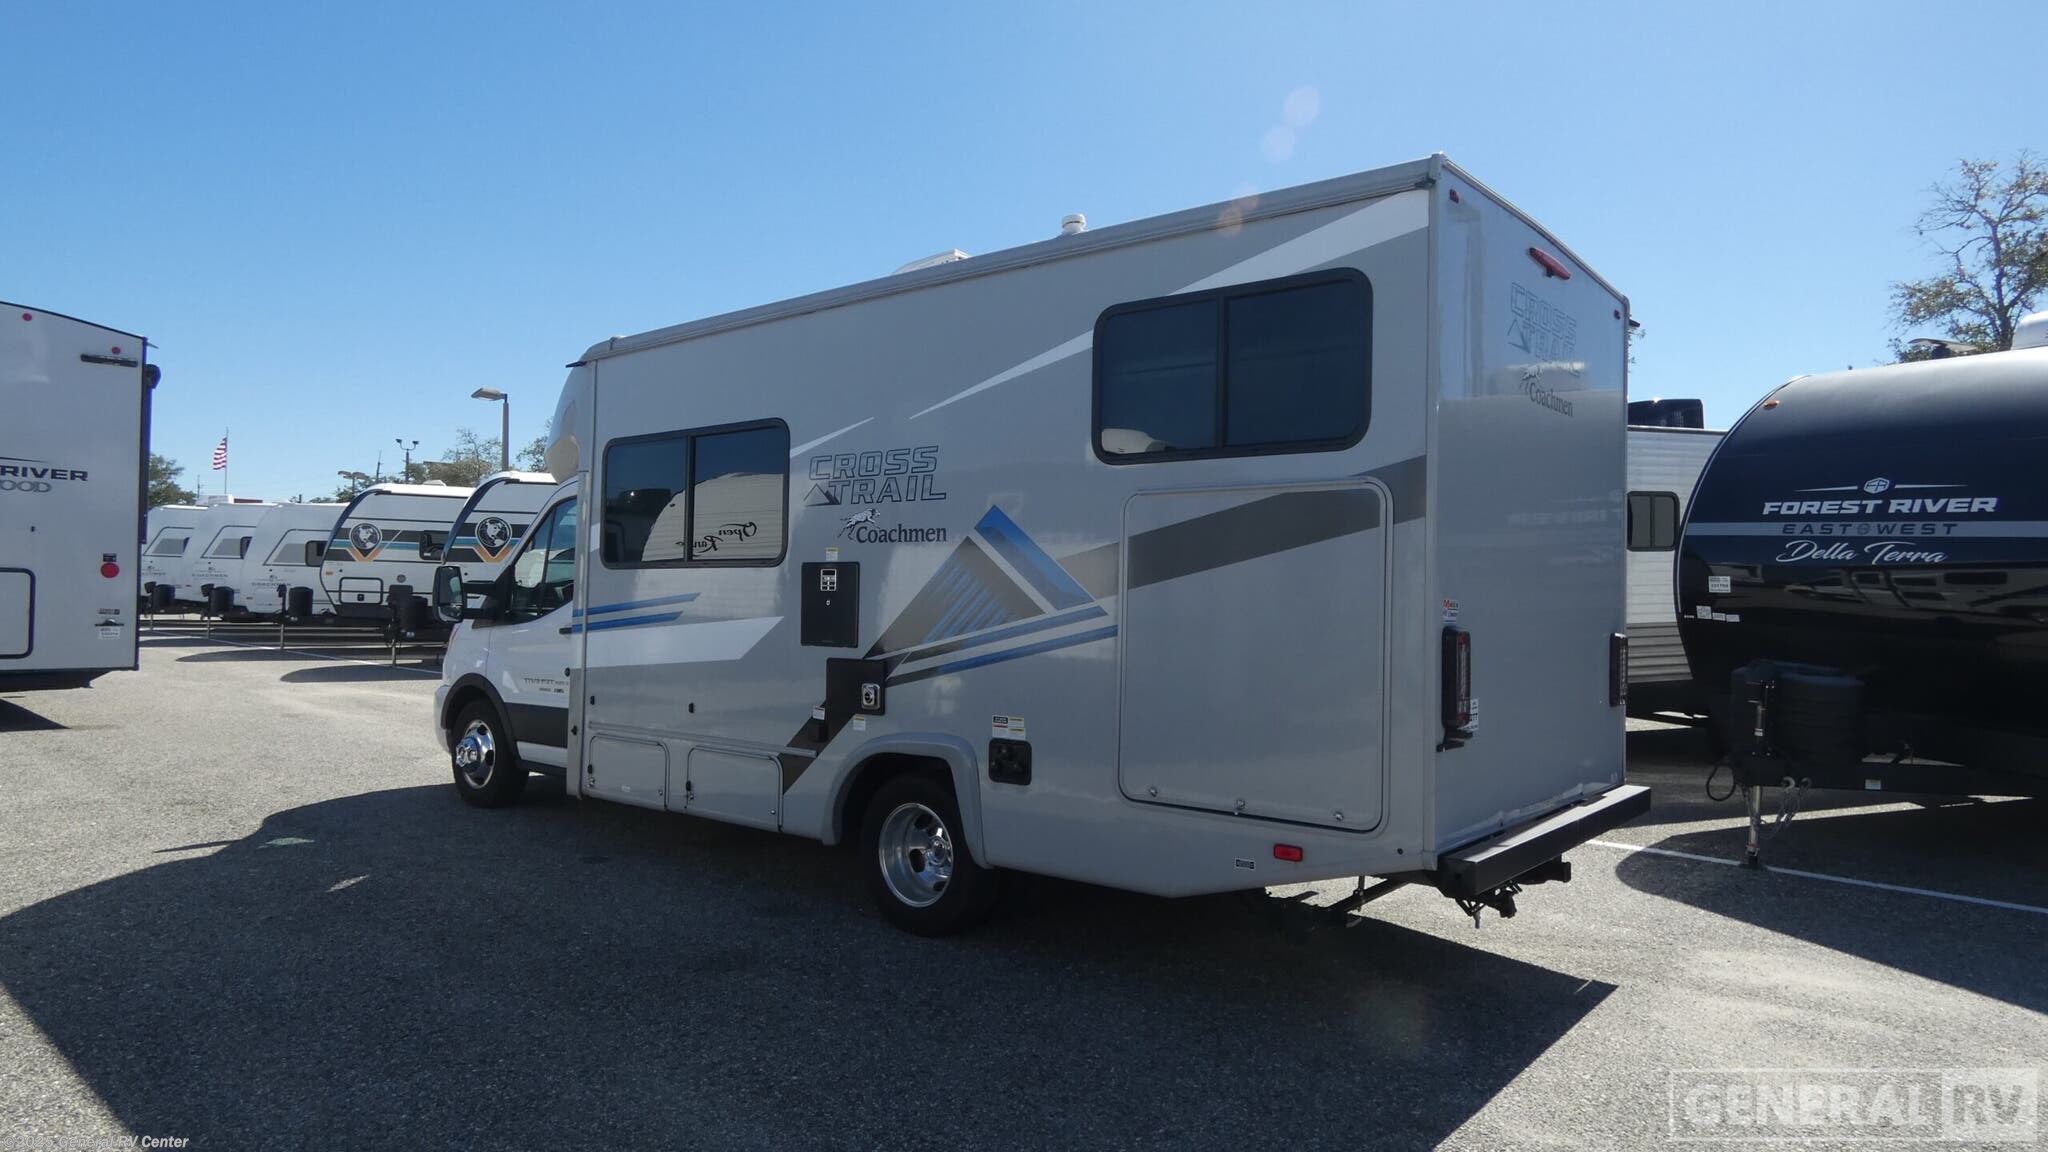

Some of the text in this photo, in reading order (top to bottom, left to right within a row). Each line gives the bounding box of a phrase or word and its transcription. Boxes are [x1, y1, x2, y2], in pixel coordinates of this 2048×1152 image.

[1529, 382, 1574, 417] Coachmen
[0, 464, 88, 482] RIVER
[809, 445, 939, 480] CROSS
[828, 474, 947, 505] TRAIL
[1762, 497, 1998, 515] FOREST RIVER
[856, 523, 947, 544] Coachmen
[1782, 523, 1958, 535] EAST WEST
[1775, 539, 1947, 565] Della Terra
